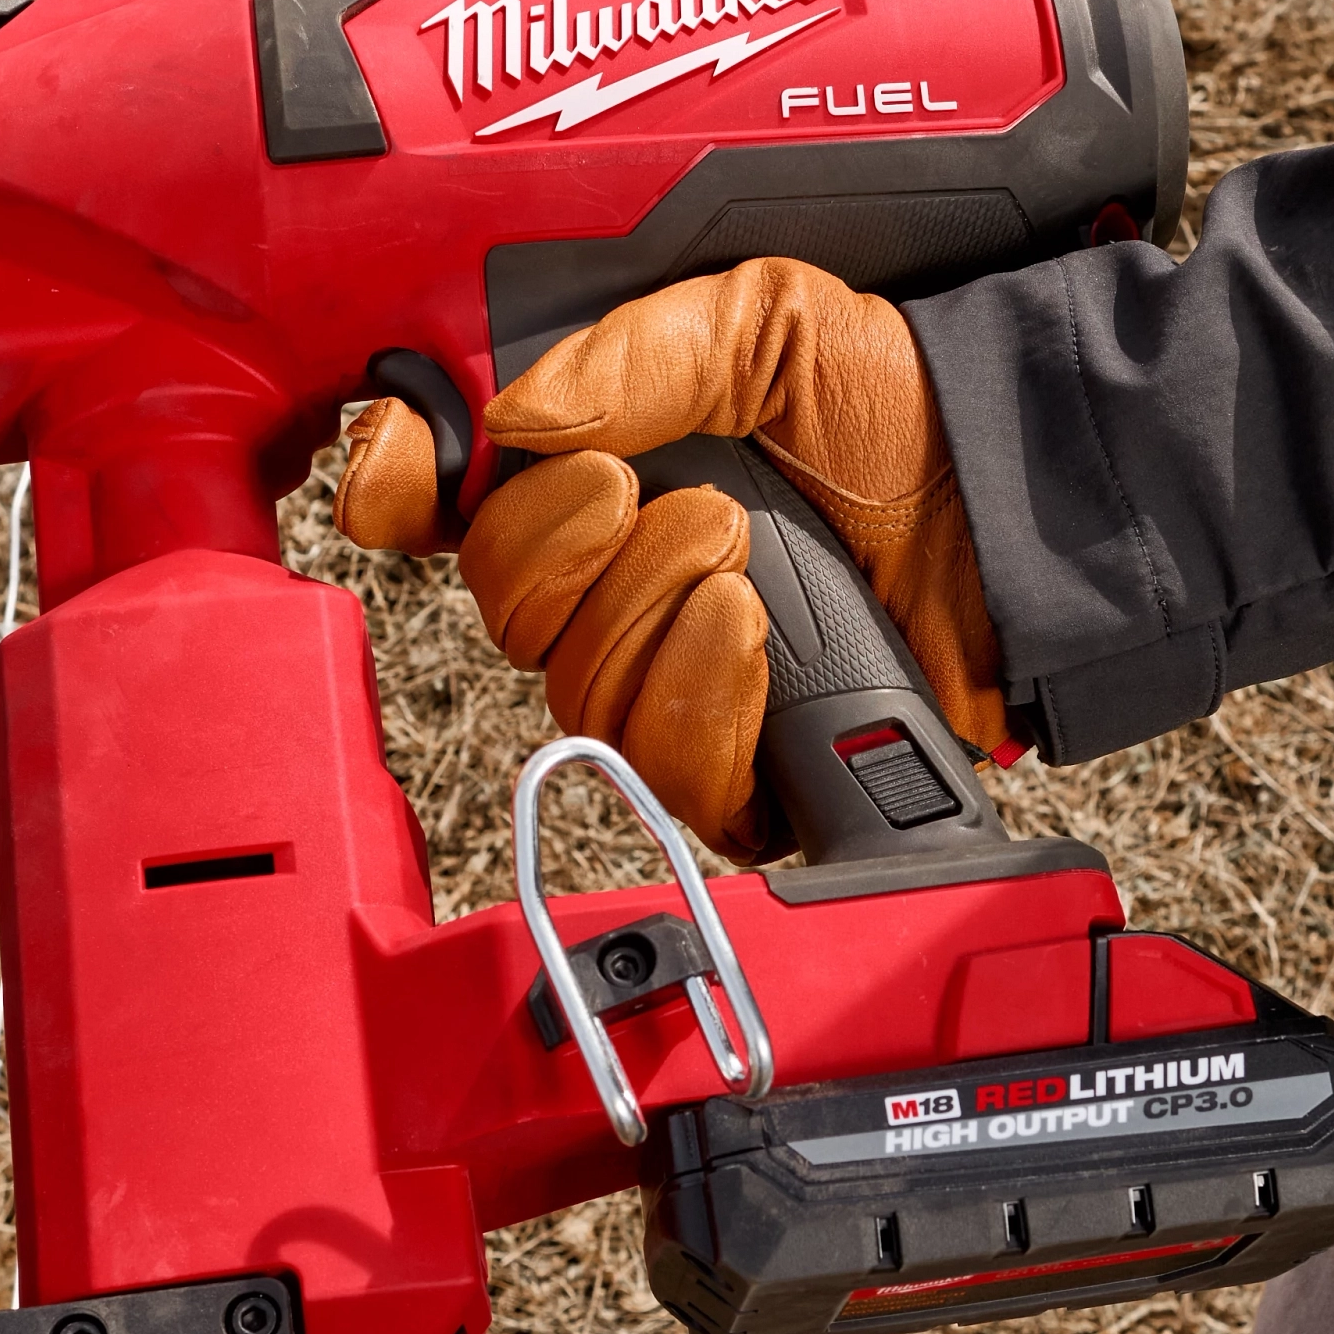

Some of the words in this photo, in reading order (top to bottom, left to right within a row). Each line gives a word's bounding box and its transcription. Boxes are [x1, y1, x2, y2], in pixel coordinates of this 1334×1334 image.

[782, 80, 958, 119] FUEL
[885, 1122, 978, 1154] HIGH
[988, 1099, 1134, 1140] OUTPUT
[1142, 1086, 1254, 1120] CP3.0
[890, 1095, 955, 1120] M18
[975, 1052, 1246, 1113] REDLITHIUM
